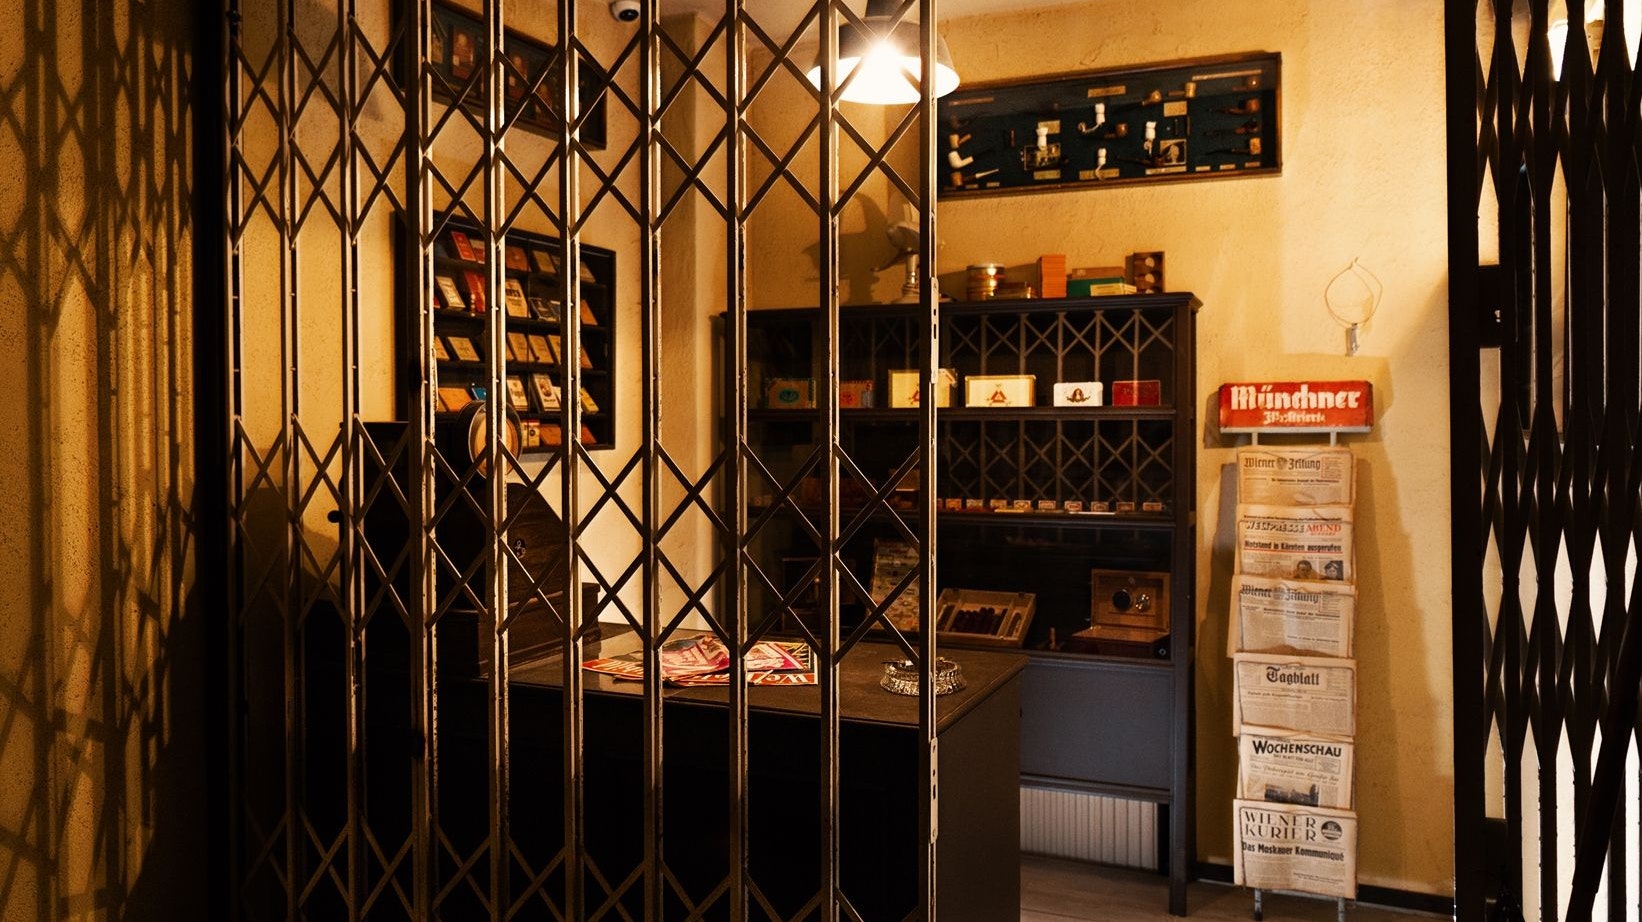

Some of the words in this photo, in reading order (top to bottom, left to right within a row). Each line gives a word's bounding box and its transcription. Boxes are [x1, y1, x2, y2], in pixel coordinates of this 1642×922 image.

[1230, 384, 1361, 410] Münchner
[1244, 457, 1276, 469] Wiener
[1288, 458, 1320, 472] Zeitung
[1306, 523, 1342, 533] ABEND
[1244, 540, 1272, 549] Notstand
[1307, 543, 1341, 552] ausgerufen
[1240, 584, 1272, 598] Wiener
[1266, 666, 1320, 685] Tagblatt
[1252, 740, 1342, 757] WOCHENSCHAU
[1244, 811, 1316, 829] WIENER
[1245, 824, 1316, 842] KURIER
[1242, 841, 1256, 852] Das
[1258, 844, 1293, 855] Moskauer
[1295, 846, 1344, 861] Kommuniqué
